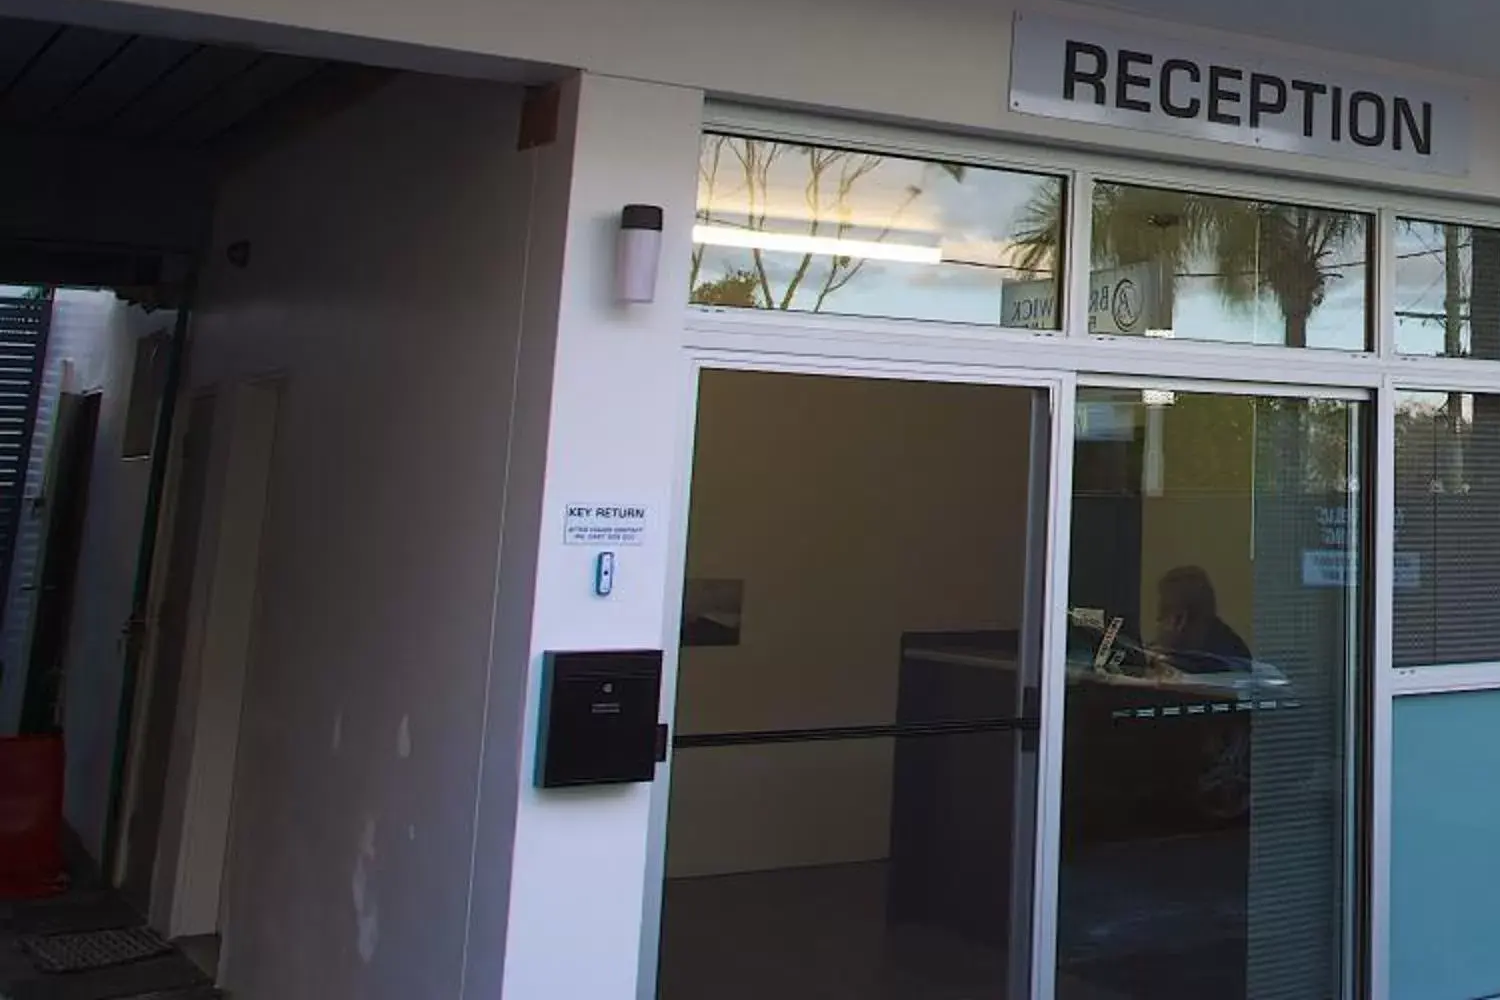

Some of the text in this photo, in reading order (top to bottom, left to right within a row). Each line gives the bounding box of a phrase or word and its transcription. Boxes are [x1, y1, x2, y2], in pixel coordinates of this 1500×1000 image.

[1063, 40, 1432, 155] RECEPTION
[568, 507, 645, 518] KEY RETURN
